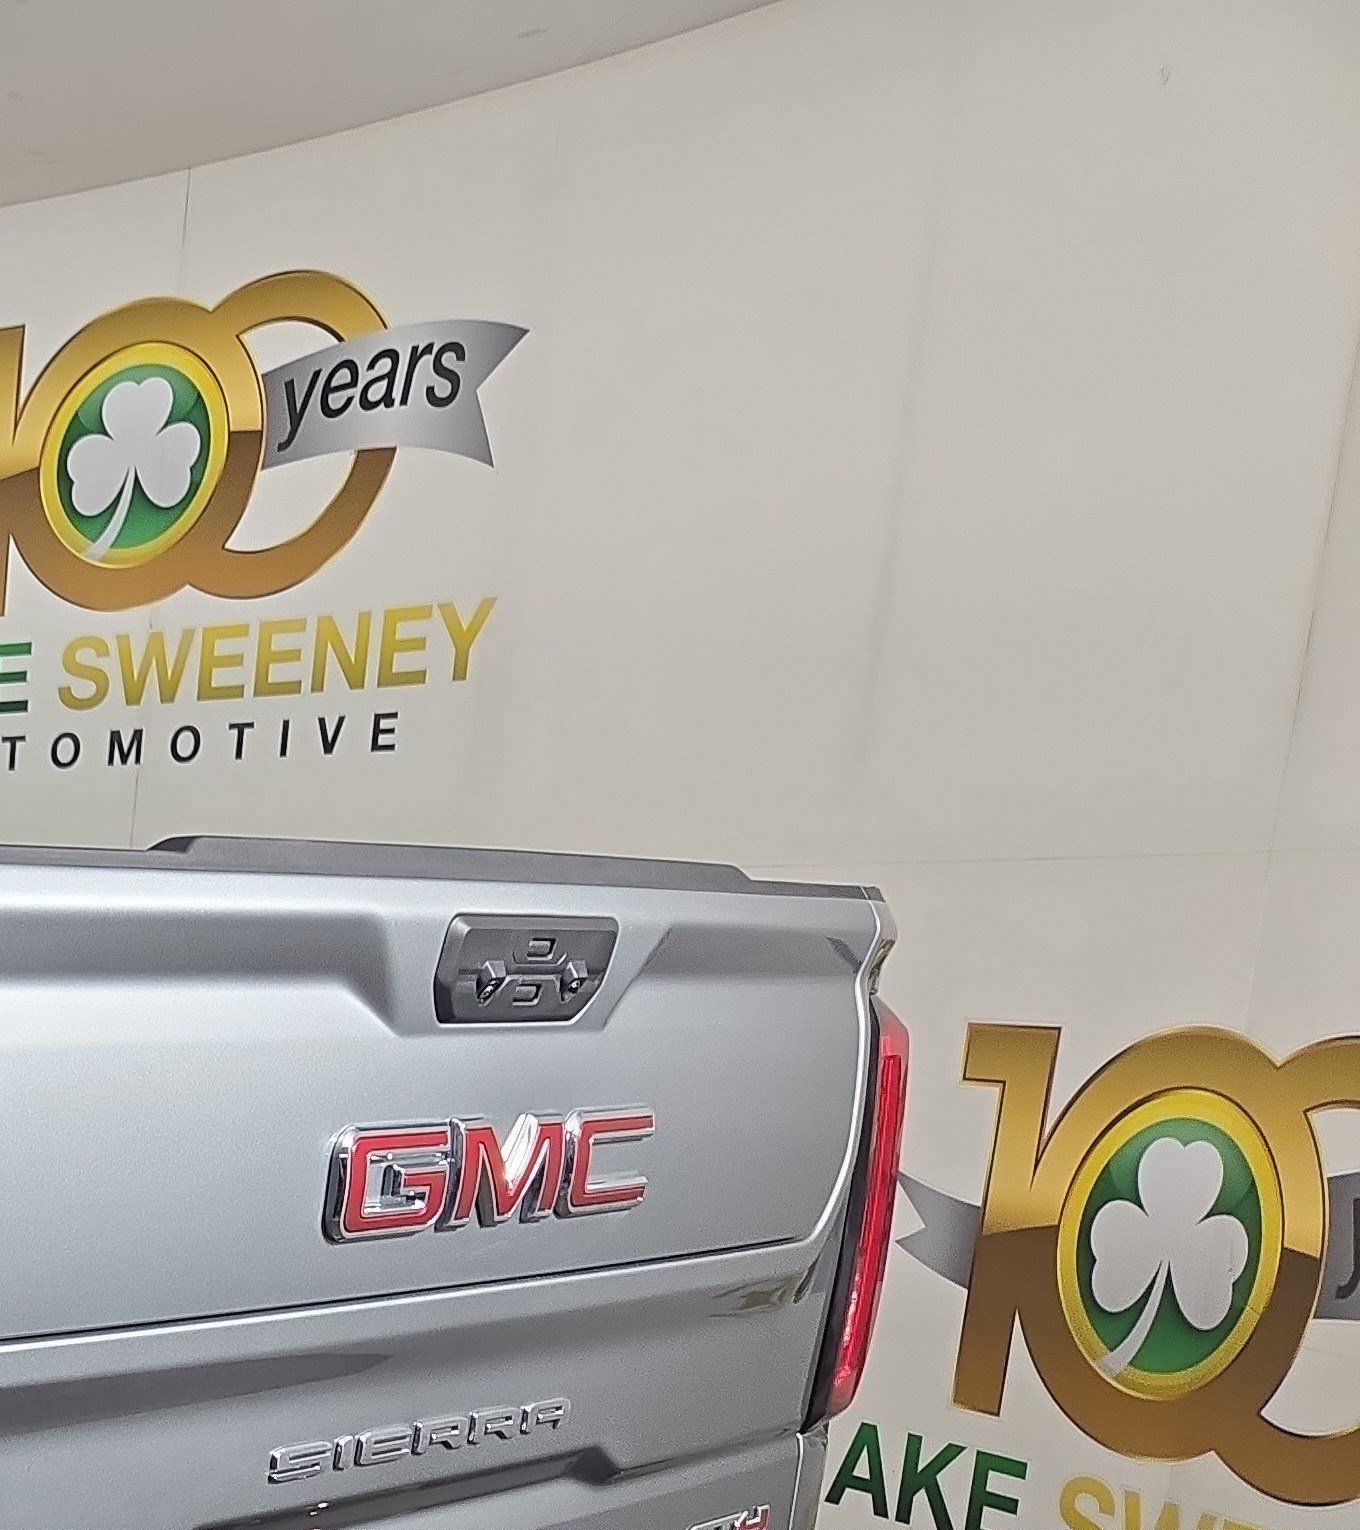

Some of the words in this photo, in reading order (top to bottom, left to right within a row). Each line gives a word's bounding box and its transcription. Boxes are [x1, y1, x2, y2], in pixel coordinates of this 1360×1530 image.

[277, 340, 467, 452] years
[56, 597, 498, 712] SWEENEY
[322, 1104, 655, 1244] GMC
[267, 1397, 572, 1485] SIERRA
